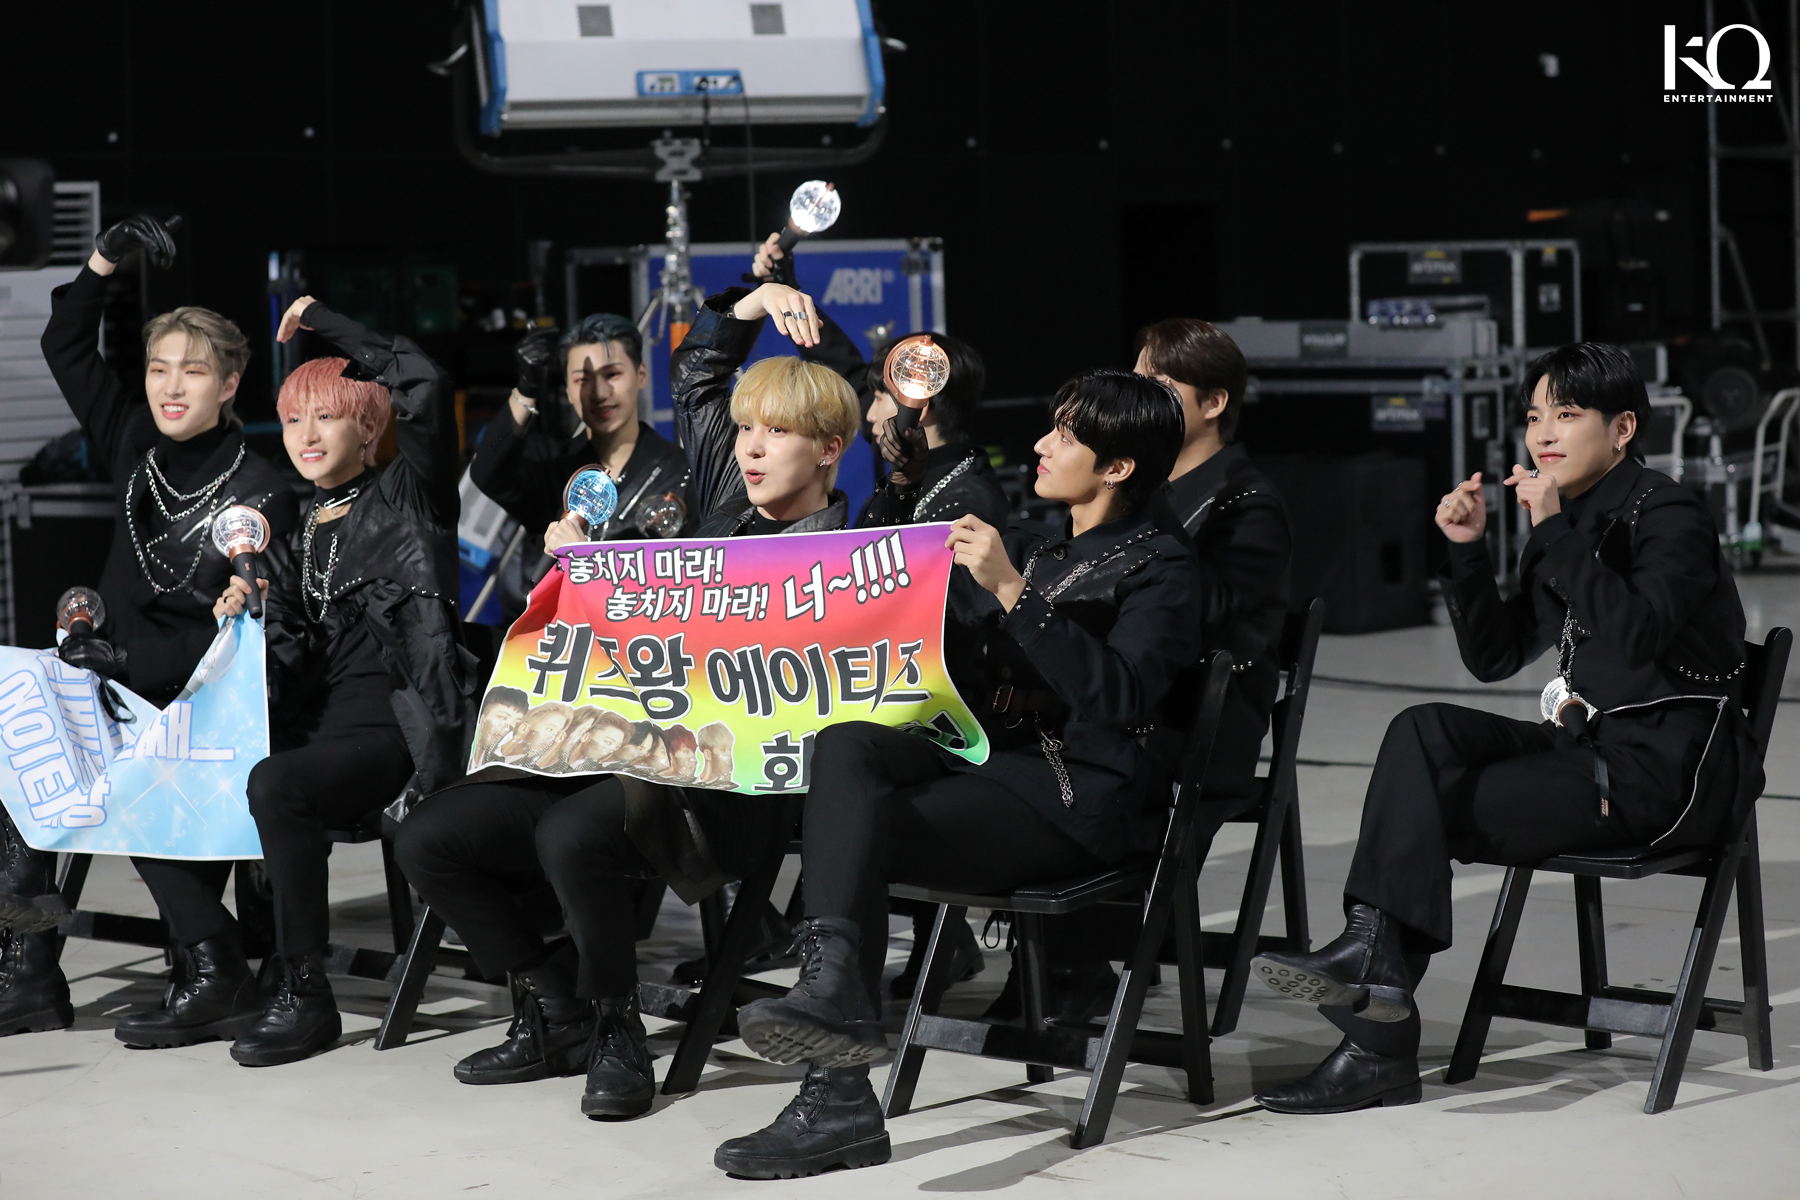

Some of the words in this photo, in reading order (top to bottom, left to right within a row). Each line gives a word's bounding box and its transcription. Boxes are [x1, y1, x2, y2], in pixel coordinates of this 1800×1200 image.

[822, 267, 884, 305] ARRI
[568, 549, 646, 585] 놓치지
[655, 545, 726, 583] 마라!
[606, 585, 692, 623] 놓치지
[701, 585, 769, 621] 마라!
[526, 619, 695, 721] 퀴즈왕
[706, 637, 934, 719] 에이티즈
